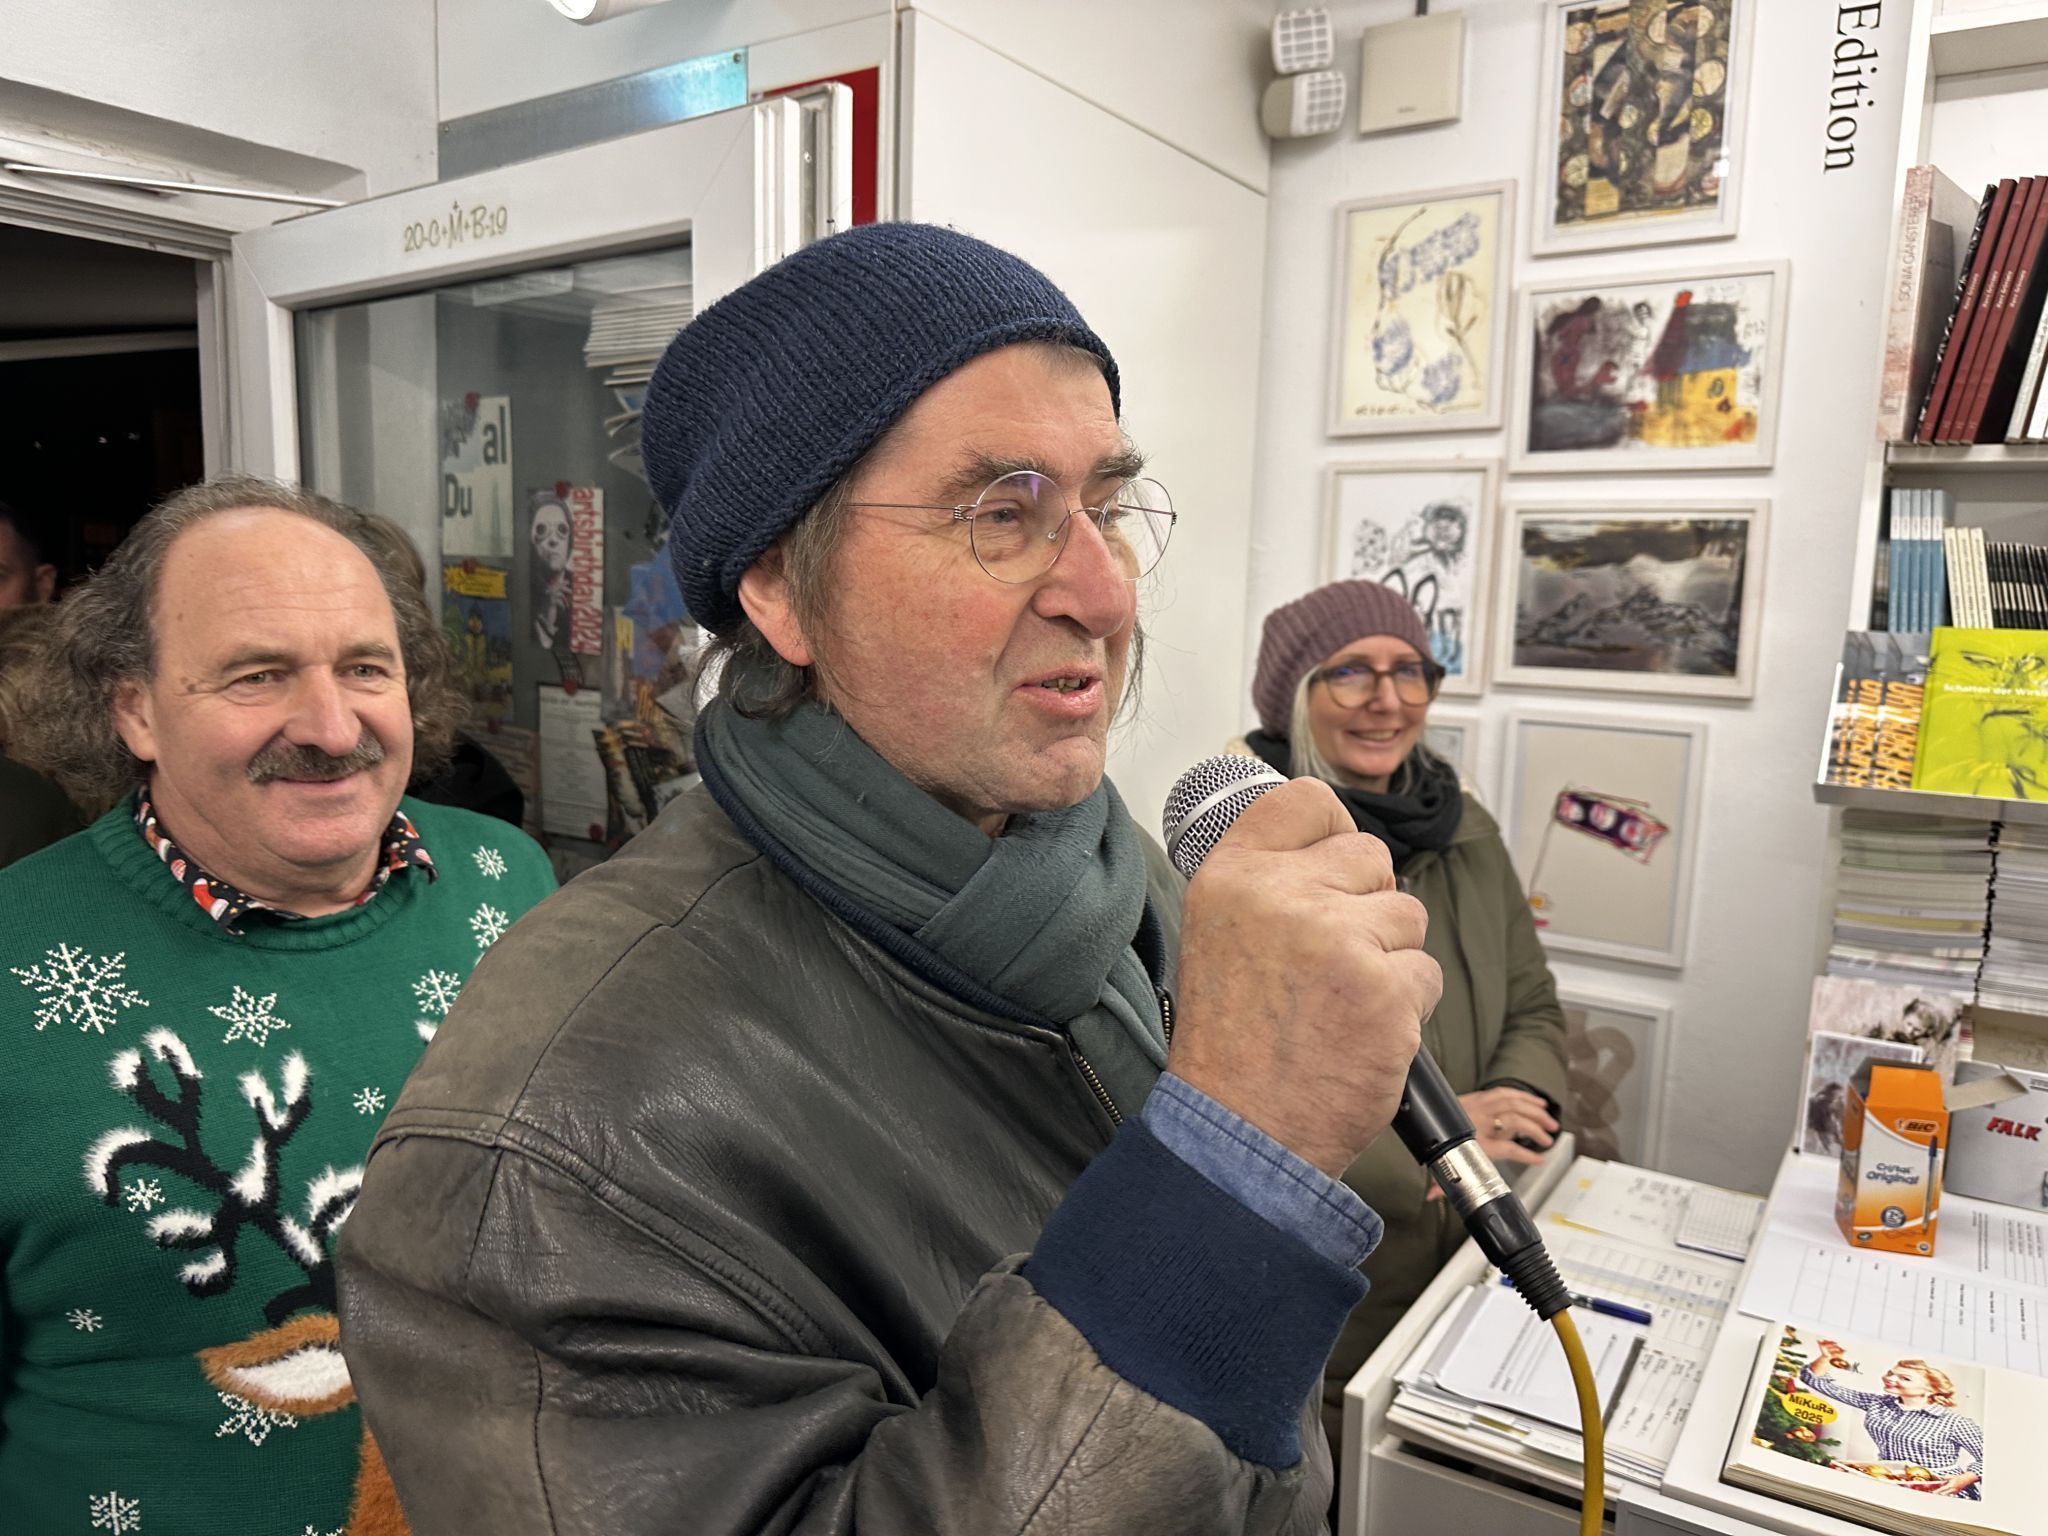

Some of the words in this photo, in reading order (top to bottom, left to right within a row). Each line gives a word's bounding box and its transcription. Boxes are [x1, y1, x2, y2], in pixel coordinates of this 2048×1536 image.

[1823, 0, 1883, 174] Edition
[444, 473, 472, 517] Du
[1986, 1116, 2042, 1141] FALK
[1866, 1170, 1919, 1185] Original
[1788, 1393, 1834, 1415] MiKuRa
[1794, 1407, 1823, 1424] 2025
